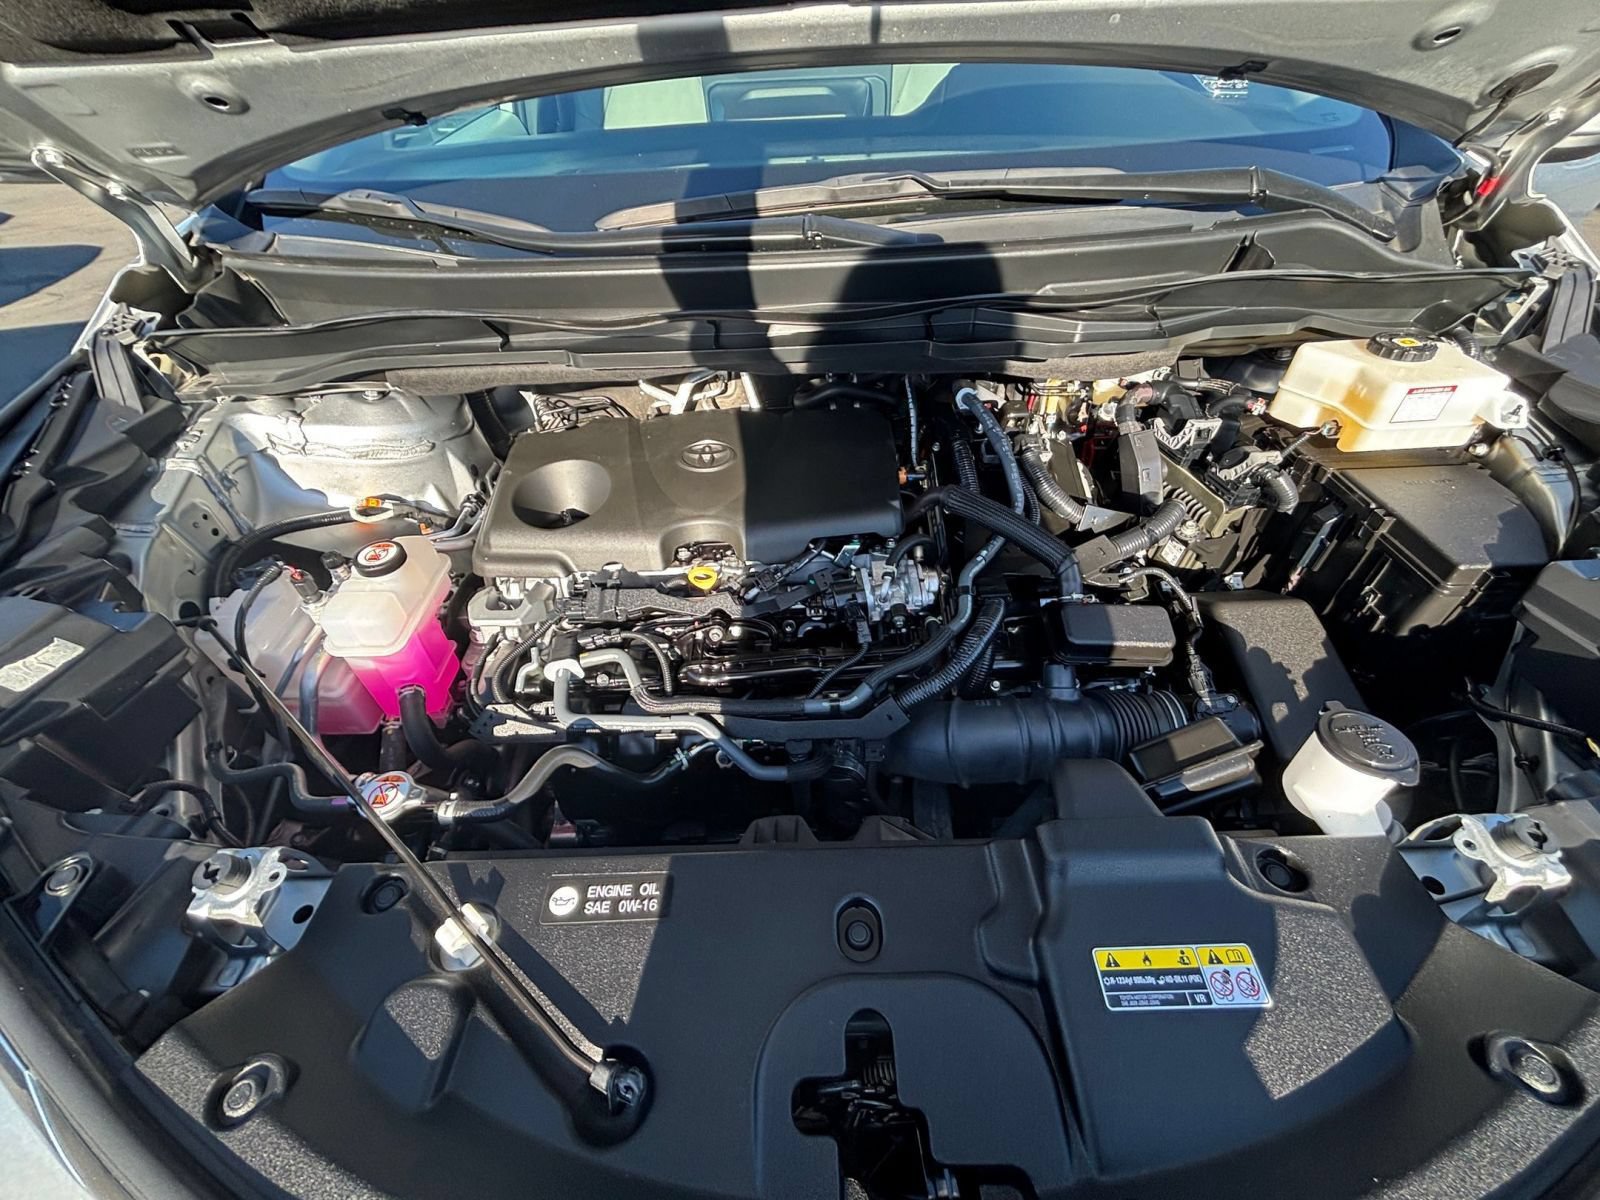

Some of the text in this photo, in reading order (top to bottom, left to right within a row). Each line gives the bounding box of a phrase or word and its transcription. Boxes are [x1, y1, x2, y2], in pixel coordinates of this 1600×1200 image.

[587, 882, 660, 898] ENGINE OIL
[584, 899, 658, 914] SAE 0W-16
[1194, 994, 1207, 1004] VR
